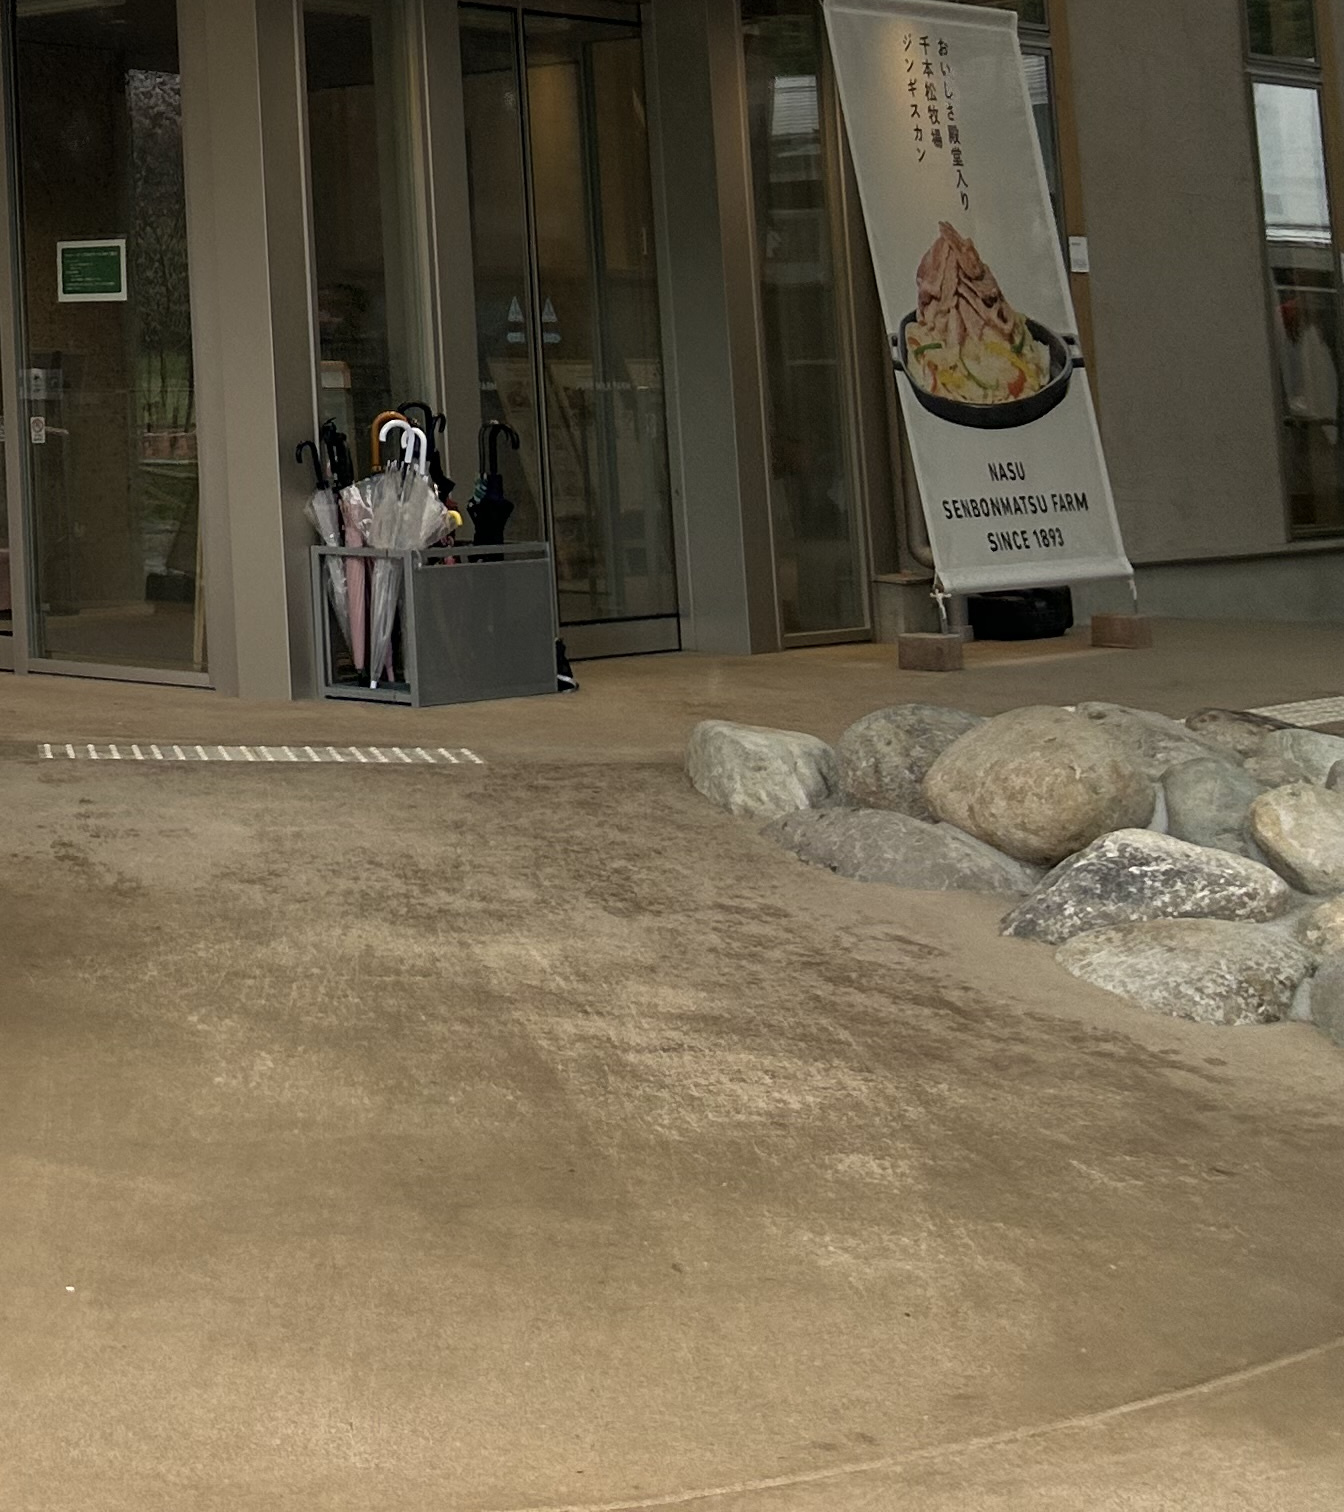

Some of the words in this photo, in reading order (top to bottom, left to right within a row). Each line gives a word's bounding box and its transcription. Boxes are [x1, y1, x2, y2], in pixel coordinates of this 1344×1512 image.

[902, 32, 926, 163] ジンギスカン
[918, 35, 943, 149] 千本松牧場
[937, 37, 970, 211] おいしさ殿堂入り
[942, 493, 1048, 520] SENBONMATSU
[1051, 491, 1089, 513] FARM
[987, 461, 1026, 482] NASU
[986, 529, 1031, 553] SINCE
[1032, 526, 1065, 549] 1893
